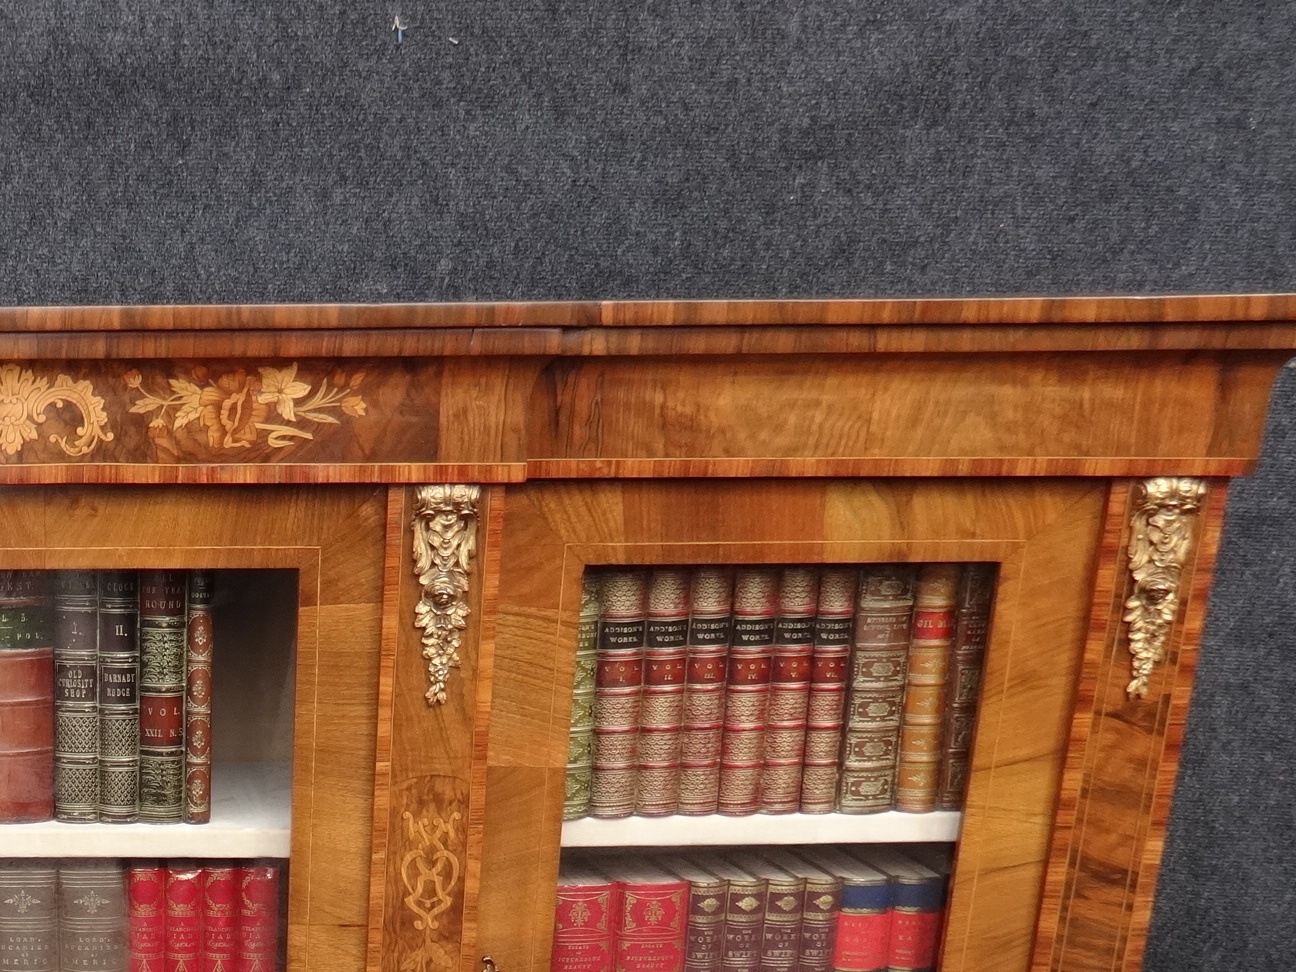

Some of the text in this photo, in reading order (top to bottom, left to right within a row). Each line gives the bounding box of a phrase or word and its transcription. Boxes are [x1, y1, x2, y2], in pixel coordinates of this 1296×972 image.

[107, 582, 134, 592] CLOCK
[145, 600, 181, 609] ROUND
[916, 620, 933, 628] GIL
[115, 624, 128, 637] II.
[68, 669, 83, 679] OLD
[104, 673, 135, 683] BARNABY
[58, 678, 94, 689] CURIOSITY
[64, 688, 87, 698] SHOP
[107, 688, 131, 697] RUDGE
